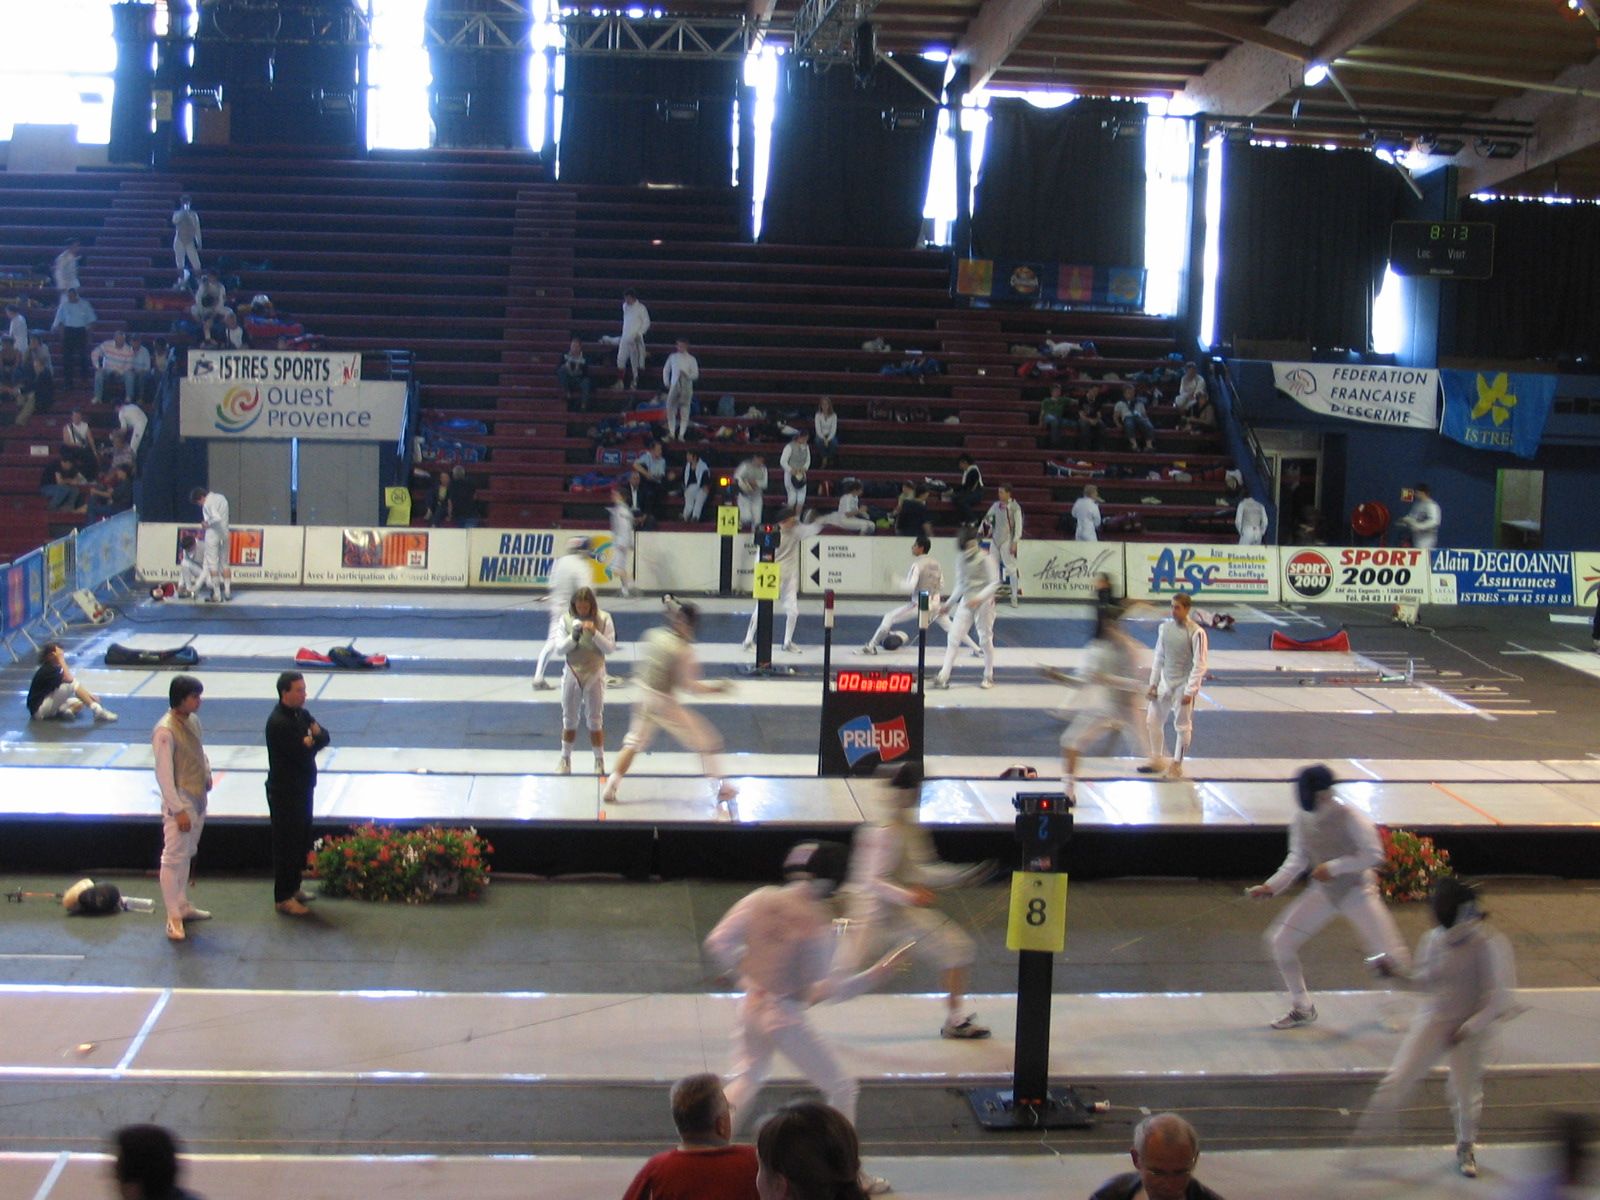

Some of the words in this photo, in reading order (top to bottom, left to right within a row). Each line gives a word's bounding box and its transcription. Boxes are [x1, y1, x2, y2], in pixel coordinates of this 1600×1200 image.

[219, 355, 269, 380] ISTRES
[273, 357, 331, 381] SPORTS
[1331, 367, 1428, 386] FEDERATION
[267, 409, 372, 428] Provence
[720, 515, 735, 527] 14
[498, 533, 555, 555] RADIO
[1339, 549, 1422, 566] SPORT
[1432, 550, 1469, 571] Alain
[1472, 551, 1570, 574] DEGIOANNI
[479, 556, 555, 582] MARITIM
[1290, 563, 1329, 574] SPORT
[1341, 568, 1411, 586] 2000
[757, 574, 777, 588] 12
[1294, 576, 1327, 588] 2000
[1474, 573, 1557, 588] Assurances
[1460, 592, 1500, 603] ISTRES
[1507, 594, 1519, 604] 04
[1522, 594, 1533, 604] 42
[1534, 594, 1545, 604] 55
[1547, 594, 1558, 604] 83
[1560, 594, 1571, 604] 83
[838, 674, 861, 691] 00
[889, 675, 911, 691] 00
[843, 727, 906, 749] PRIEUR
[1026, 898, 1047, 926] 8
